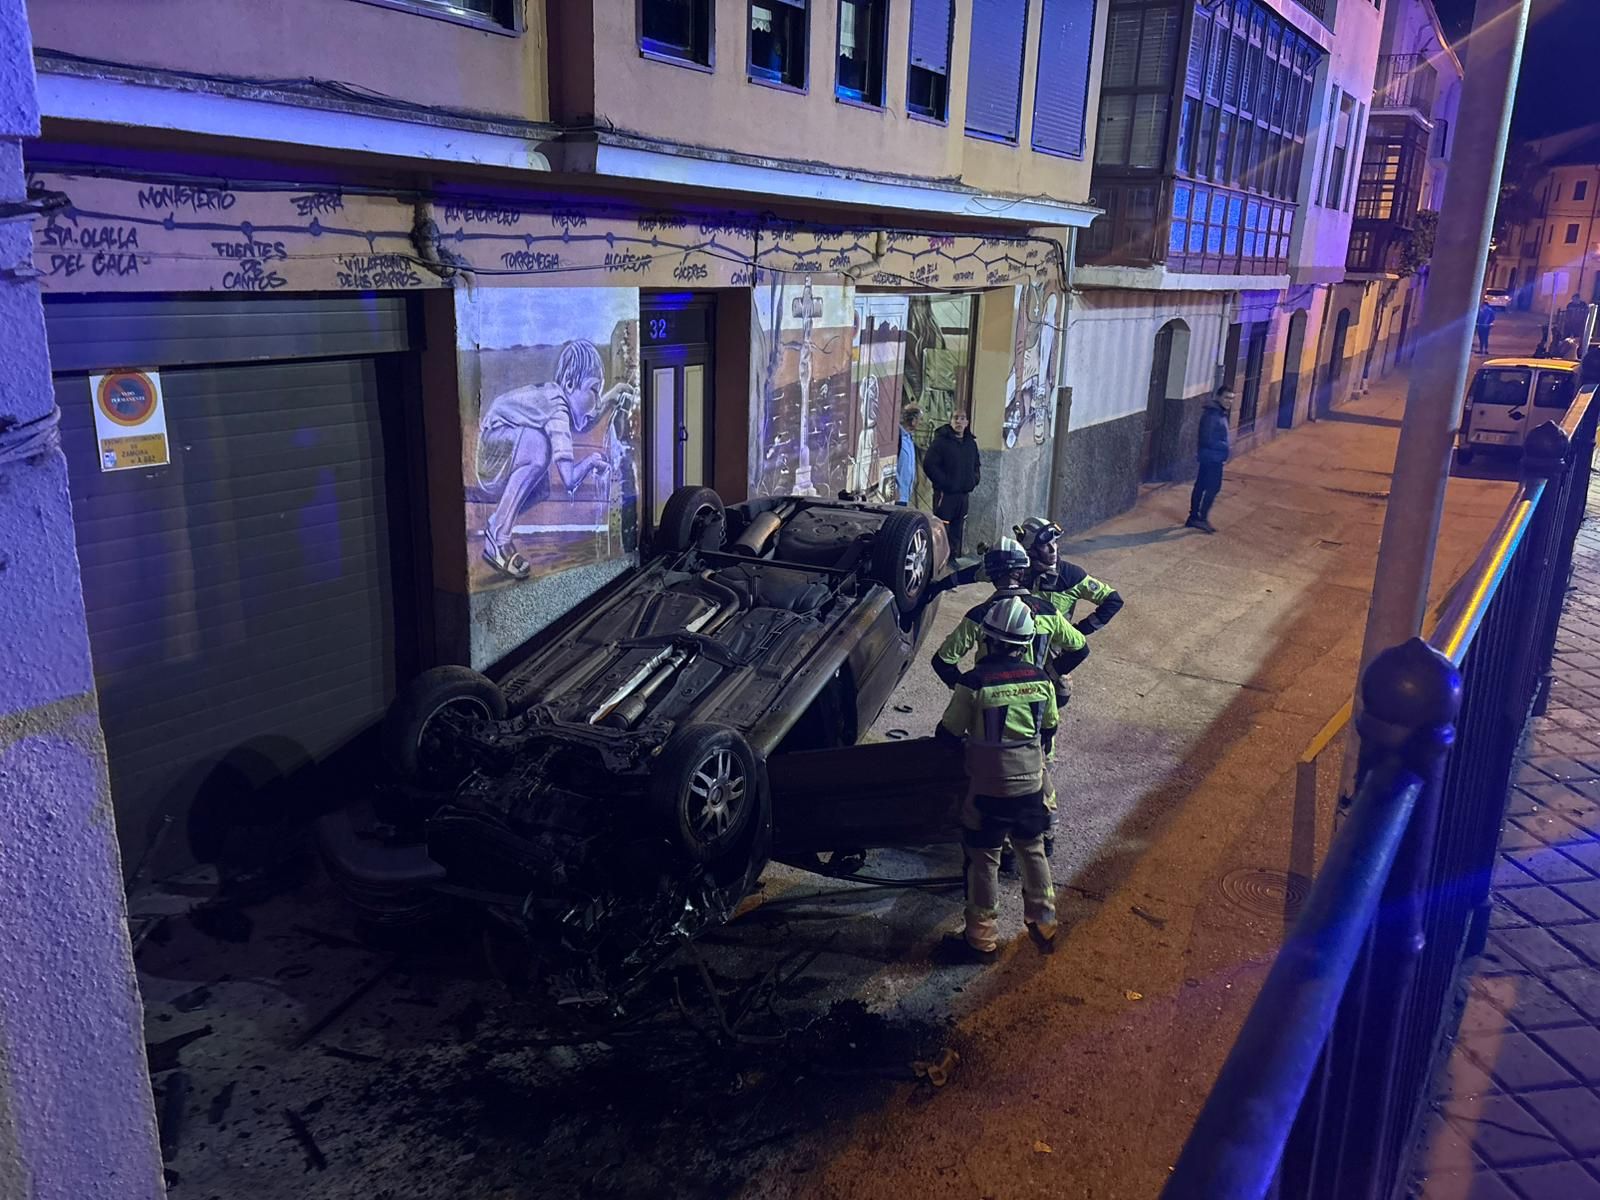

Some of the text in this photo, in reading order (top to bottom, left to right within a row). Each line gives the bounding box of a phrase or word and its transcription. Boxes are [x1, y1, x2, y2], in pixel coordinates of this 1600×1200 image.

[138, 186, 235, 212] MONASTERIO
[80, 227, 138, 249] OLALLA
[211, 241, 287, 260] FUENTES
[50, 253, 138, 276] DEL CALA
[240, 259, 264, 280] DE
[223, 271, 287, 289] CANTOS
[337, 272, 353, 287] DE
[373, 271, 422, 289] BARROS
[649, 318, 667, 339] 32
[1013, 687, 1041, 696] ZAMORA
